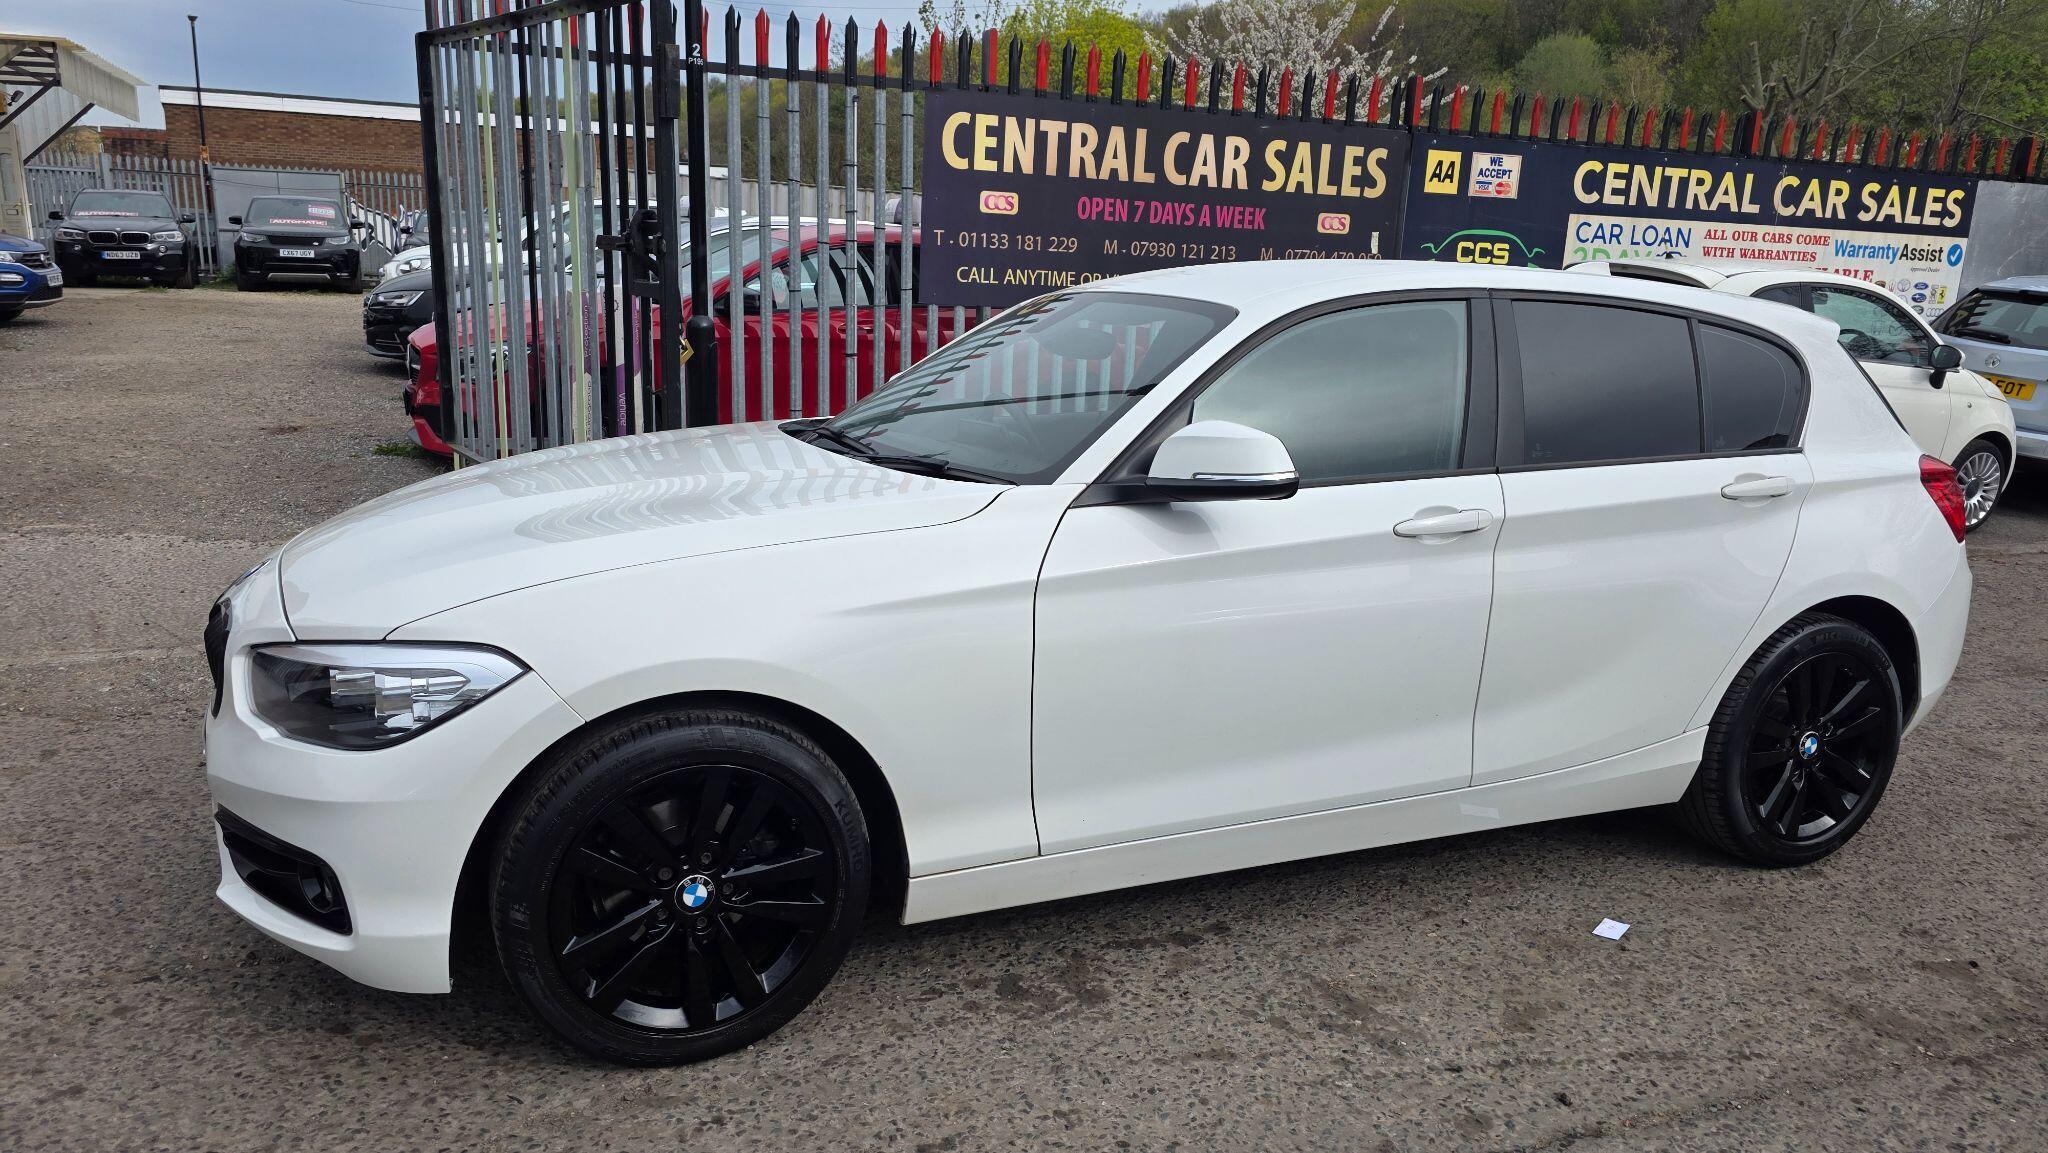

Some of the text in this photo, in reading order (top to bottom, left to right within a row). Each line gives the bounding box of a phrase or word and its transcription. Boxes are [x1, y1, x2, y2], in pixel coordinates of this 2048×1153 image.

[692, 43, 700, 57] 2
[941, 111, 1389, 199] CENTRAL CAR SALES
[1489, 156, 1504, 167] WE
[1429, 160, 1456, 183] AA
[1477, 168, 1513, 180] ACCEPT
[984, 194, 1015, 212] CCS
[1573, 160, 1966, 227] CENTRAL CAR SALES
[1077, 196, 1267, 230] OPEN 7 DAYS A WEEK
[1321, 216, 1347, 231] CCS
[959, 231, 1009, 249] 01133
[1016, 235, 1042, 251] 181
[1048, 236, 1078, 253] 229
[1575, 221, 1692, 249] CAR LOAN
[1704, 228, 1831, 246] ALL OUR CARS COME
[1130, 241, 1176, 257] 07930
[1181, 244, 1204, 259] 121
[1210, 245, 1236, 260] 213
[1456, 241, 1510, 265] CCS
[1702, 246, 1817, 262] WITH WARRANTIES
[956, 266, 998, 284] CALL
[1003, 268, 1076, 287] ANYTIME
